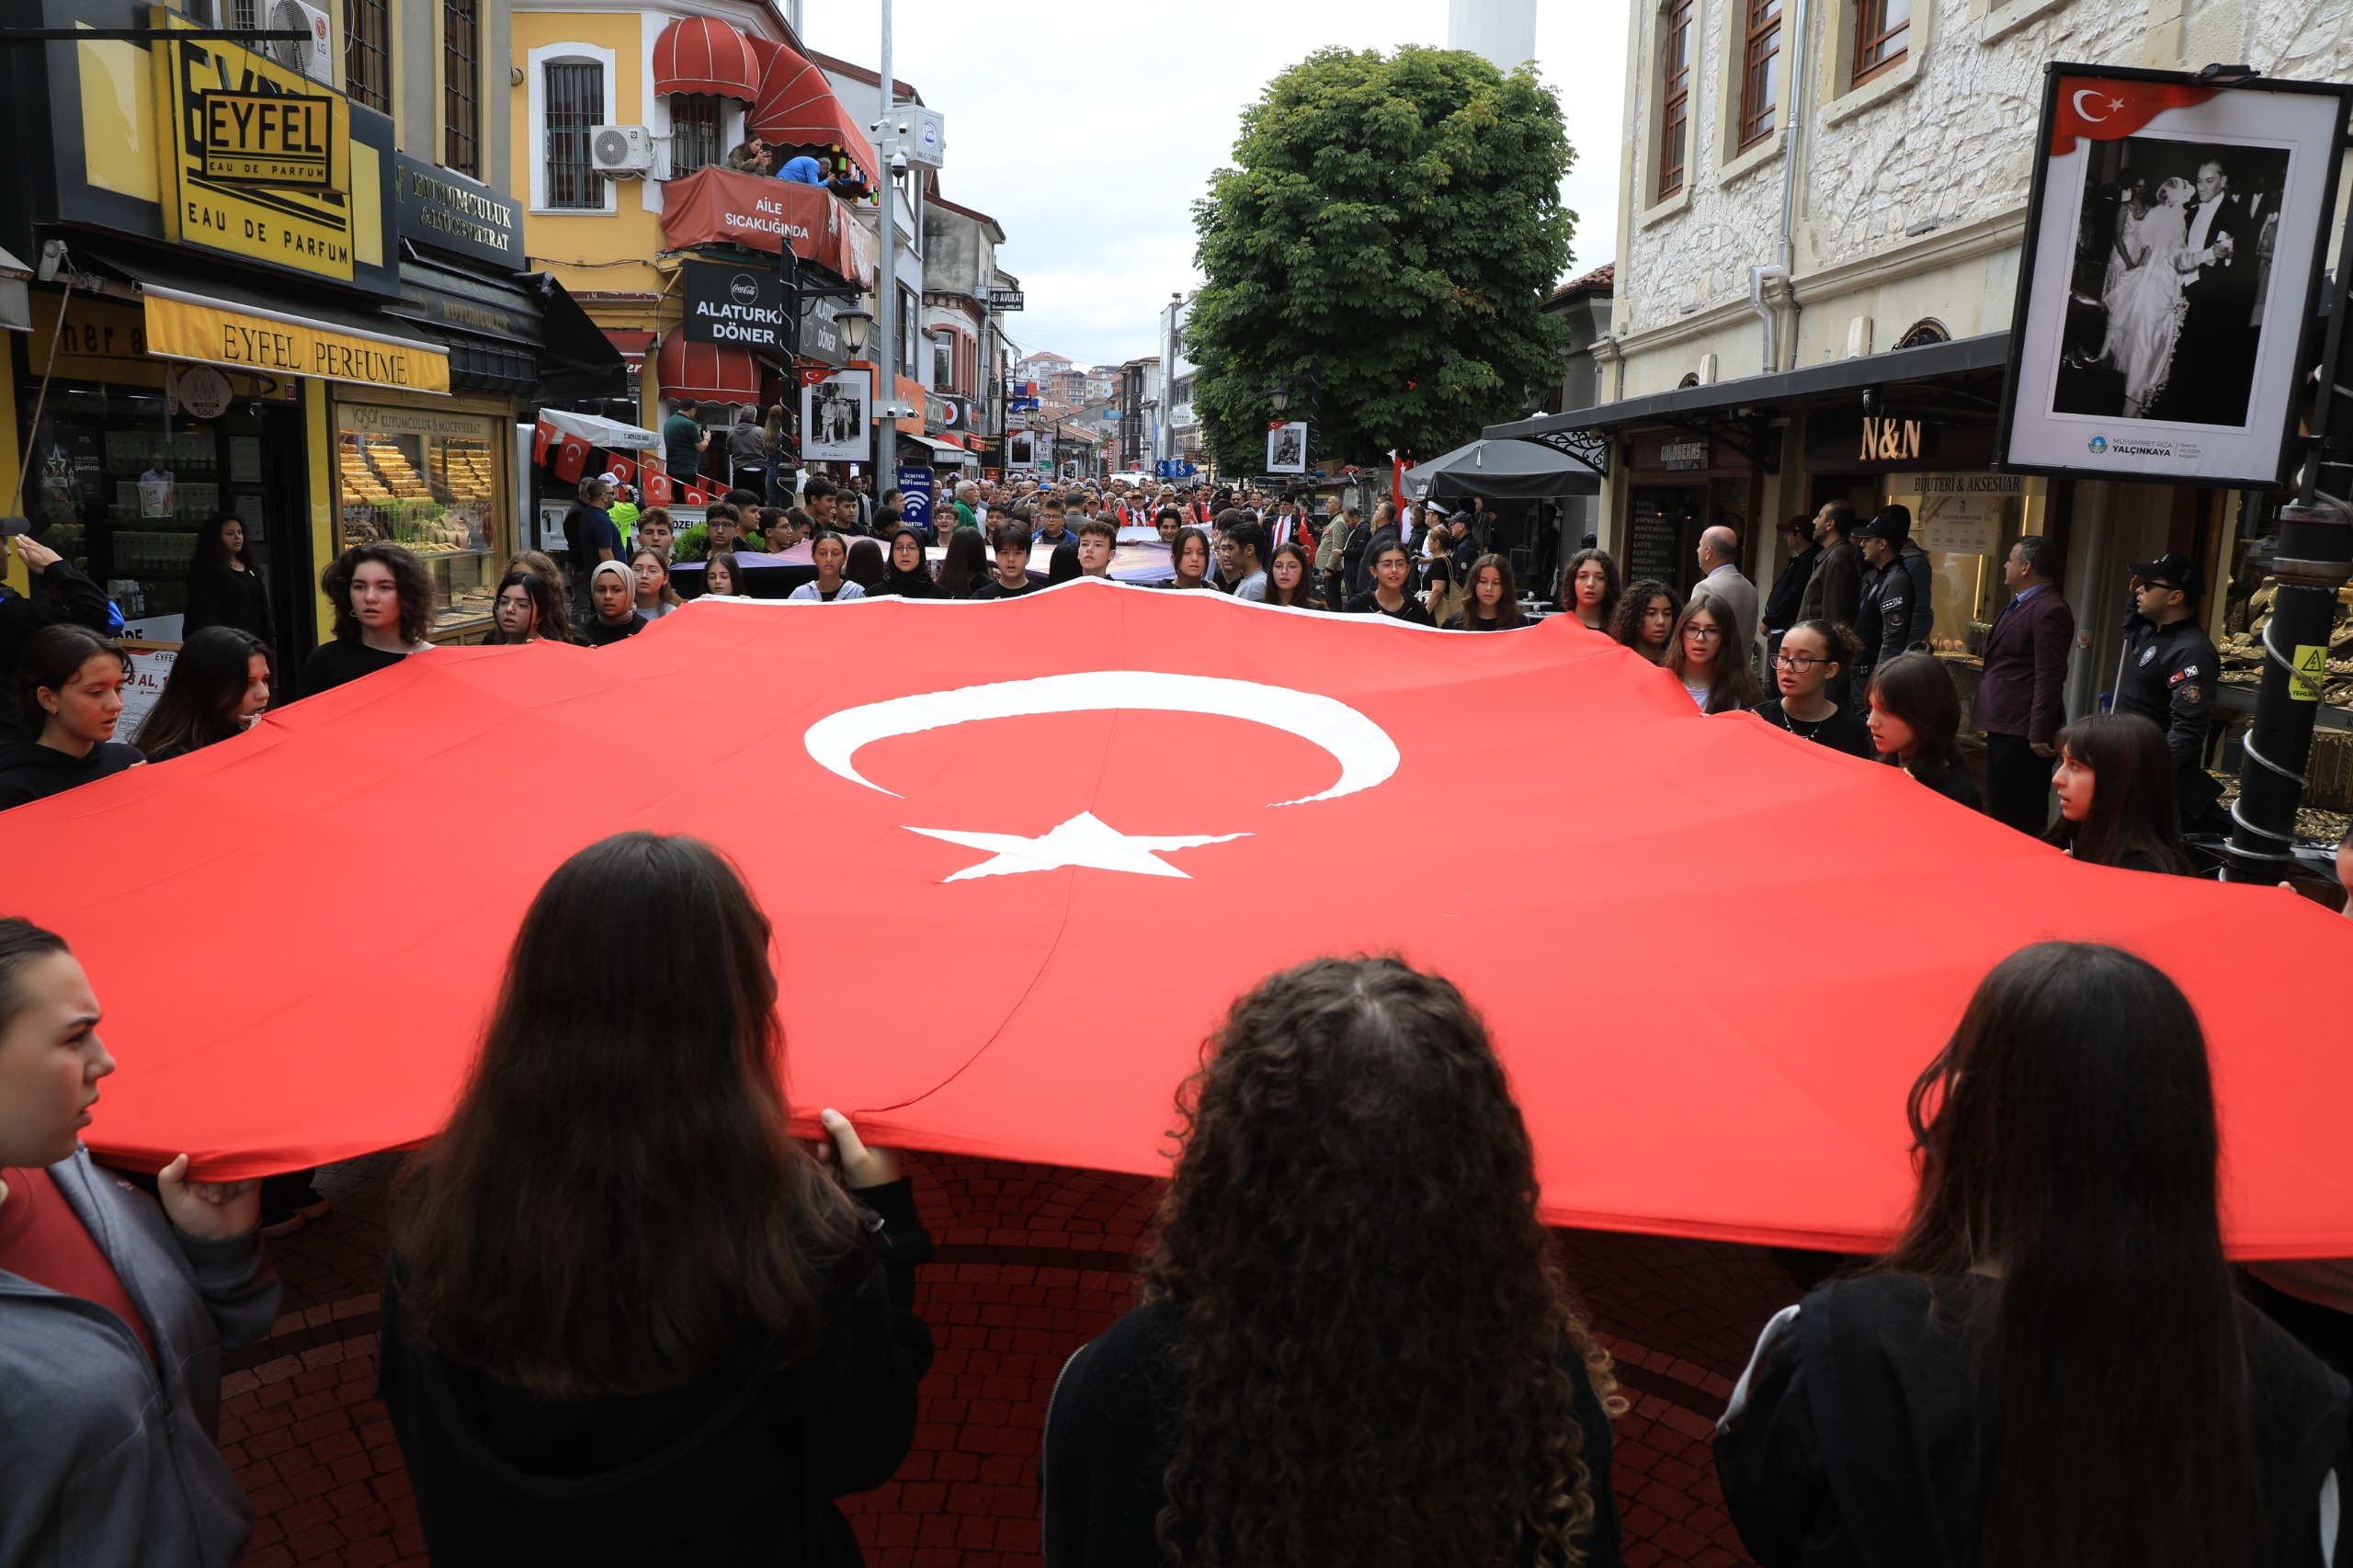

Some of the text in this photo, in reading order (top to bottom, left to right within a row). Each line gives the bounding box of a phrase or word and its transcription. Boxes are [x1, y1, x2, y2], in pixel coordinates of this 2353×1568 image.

[316, 40, 326, 55] LG
[210, 100, 324, 153] EYFEL
[210, 162, 324, 177] EAU DE PARFUM
[413, 172, 513, 229] KUYUMCULUK
[755, 196, 782, 215] AİLE
[188, 202, 347, 264] EAU DE PARFUM
[725, 212, 809, 239] SICAKLIĞINDA
[999, 292, 1023, 302] AVUKAT
[63, 312, 114, 353] her
[713, 322, 775, 344] DÖNER
[818, 325, 836, 353] DÖNER
[223, 324, 407, 384] EYFEL PERFUME
[381, 415, 431, 431] KUYUMCULUK
[438, 419, 481, 435] MÜCEVHERAT
[1859, 416, 1921, 460] N&N
[2113, 437, 2154, 447] MUHAMMET
[1661, 442, 1701, 461] GOLDBEANS
[2112, 445, 2171, 457] YALÇINKAYA
[1915, 473, 2020, 494] BİJUTERİ & AKSESUAR
